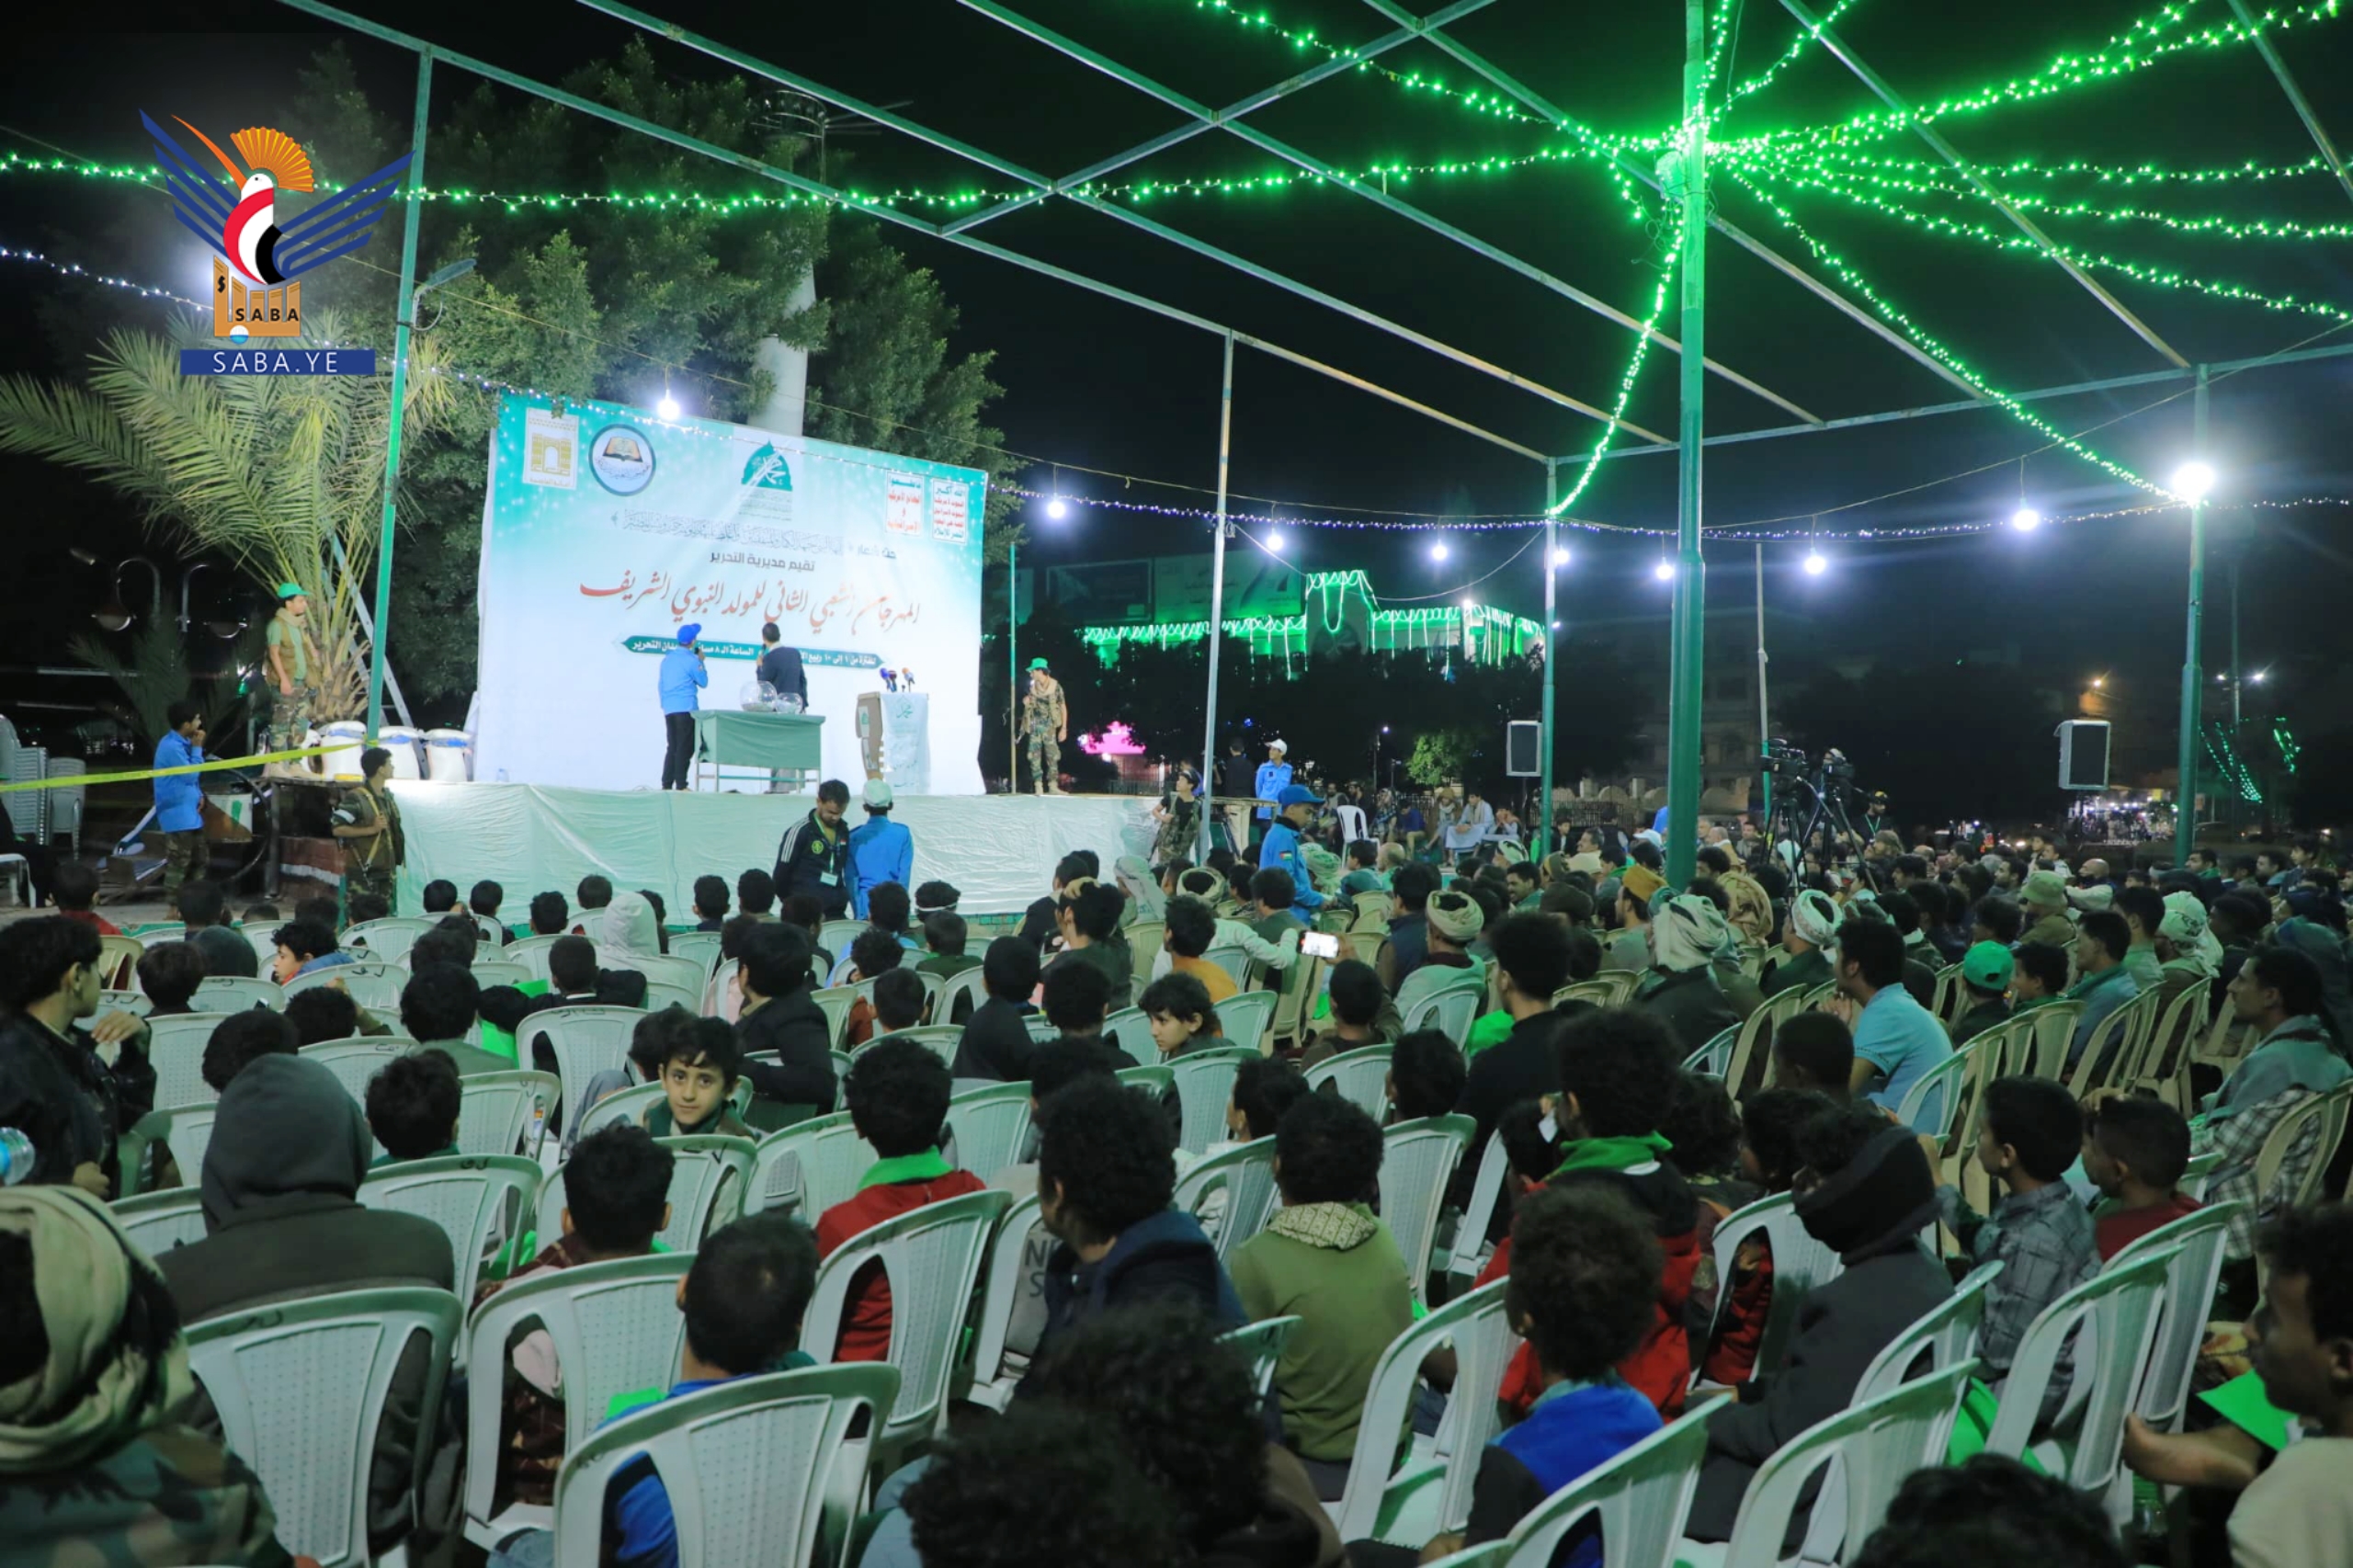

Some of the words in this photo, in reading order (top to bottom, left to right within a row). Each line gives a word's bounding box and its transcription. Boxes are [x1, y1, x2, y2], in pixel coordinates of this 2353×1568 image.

[710, 551, 745, 564] التحرير
[747, 553, 785, 569] مديرية
[788, 560, 815, 573] تقيم
[580, 569, 672, 610] الشريف
[670, 581, 724, 622] النبوي
[722, 580, 767, 617] للمولد
[631, 640, 660, 651] التحرير
[730, 644, 754, 655] الساعة
